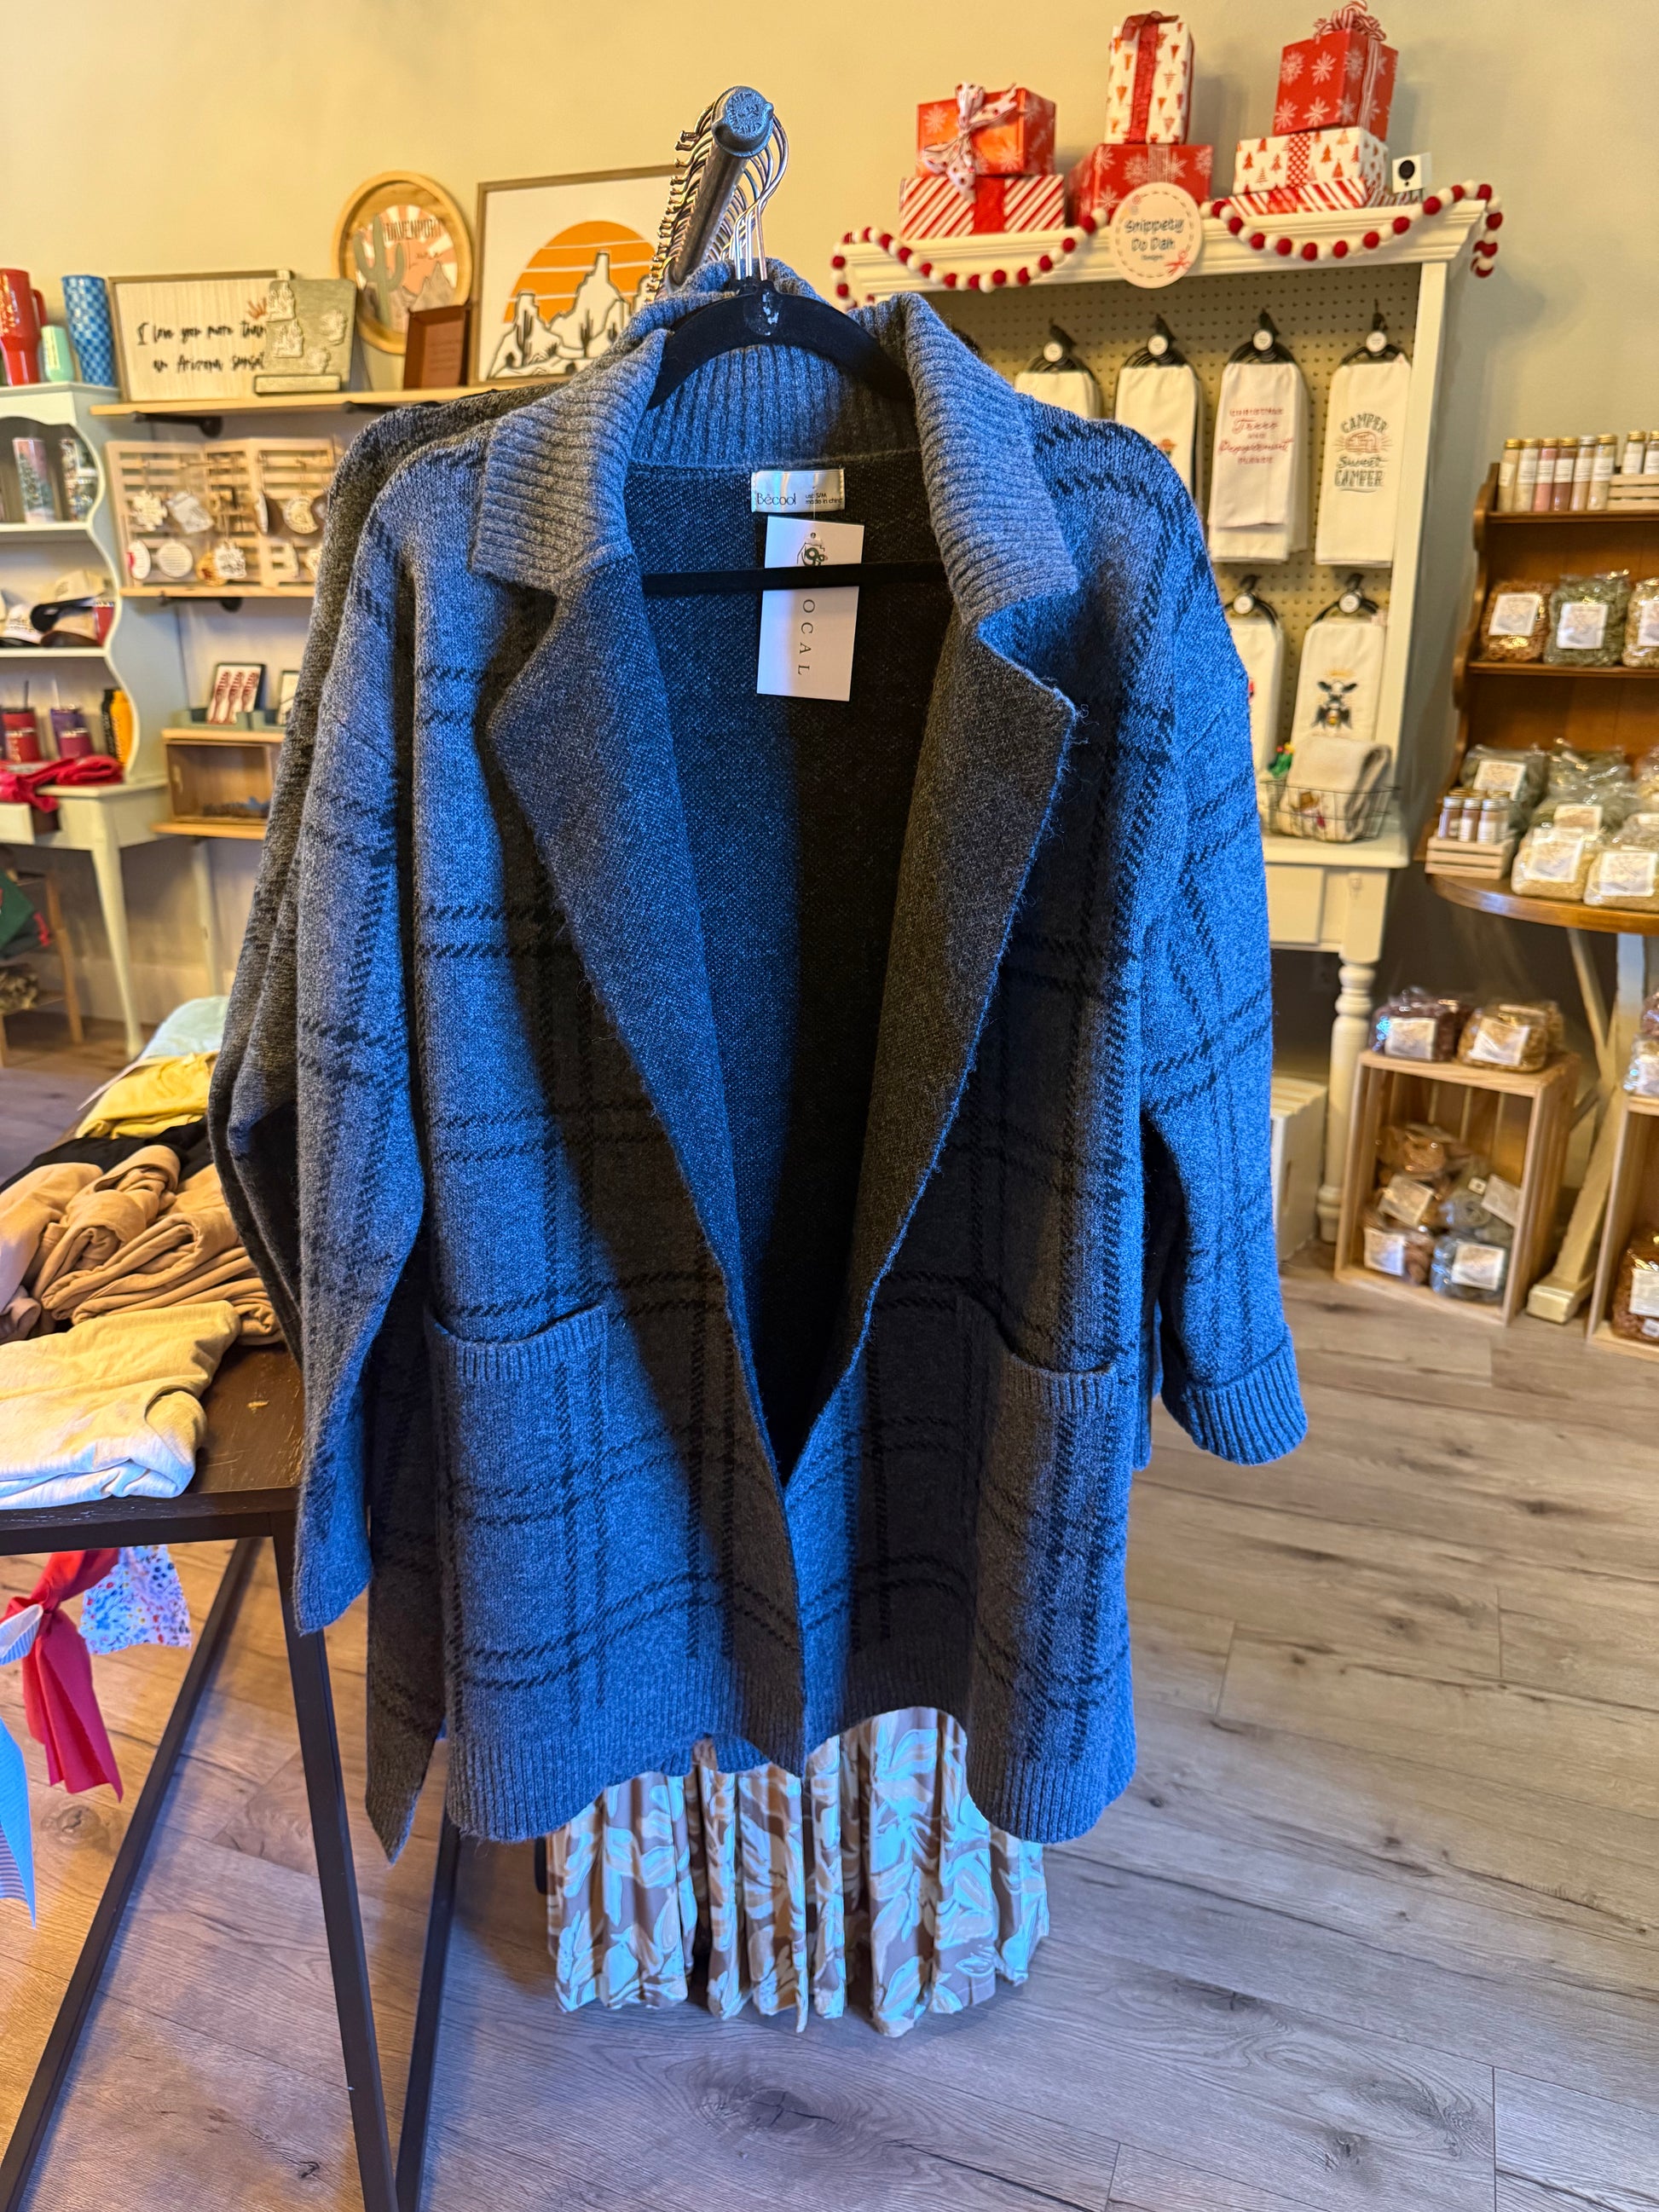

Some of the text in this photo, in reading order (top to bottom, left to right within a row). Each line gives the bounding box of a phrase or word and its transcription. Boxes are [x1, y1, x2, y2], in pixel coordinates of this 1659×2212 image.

[1124, 218, 1184, 235] Snippety
[1131, 237, 1176, 252] Do Dah
[137, 321, 149, 345] I
[153, 323, 175, 343] love
[181, 327, 202, 344] you
[207, 324, 234, 339] more
[176, 354, 223, 373] Arizona
[1341, 413, 1388, 434] CAMPER
[1337, 454, 1389, 469] Sweet
[1334, 470, 1384, 488] CAMPER
[797, 598, 816, 675] OCAL
